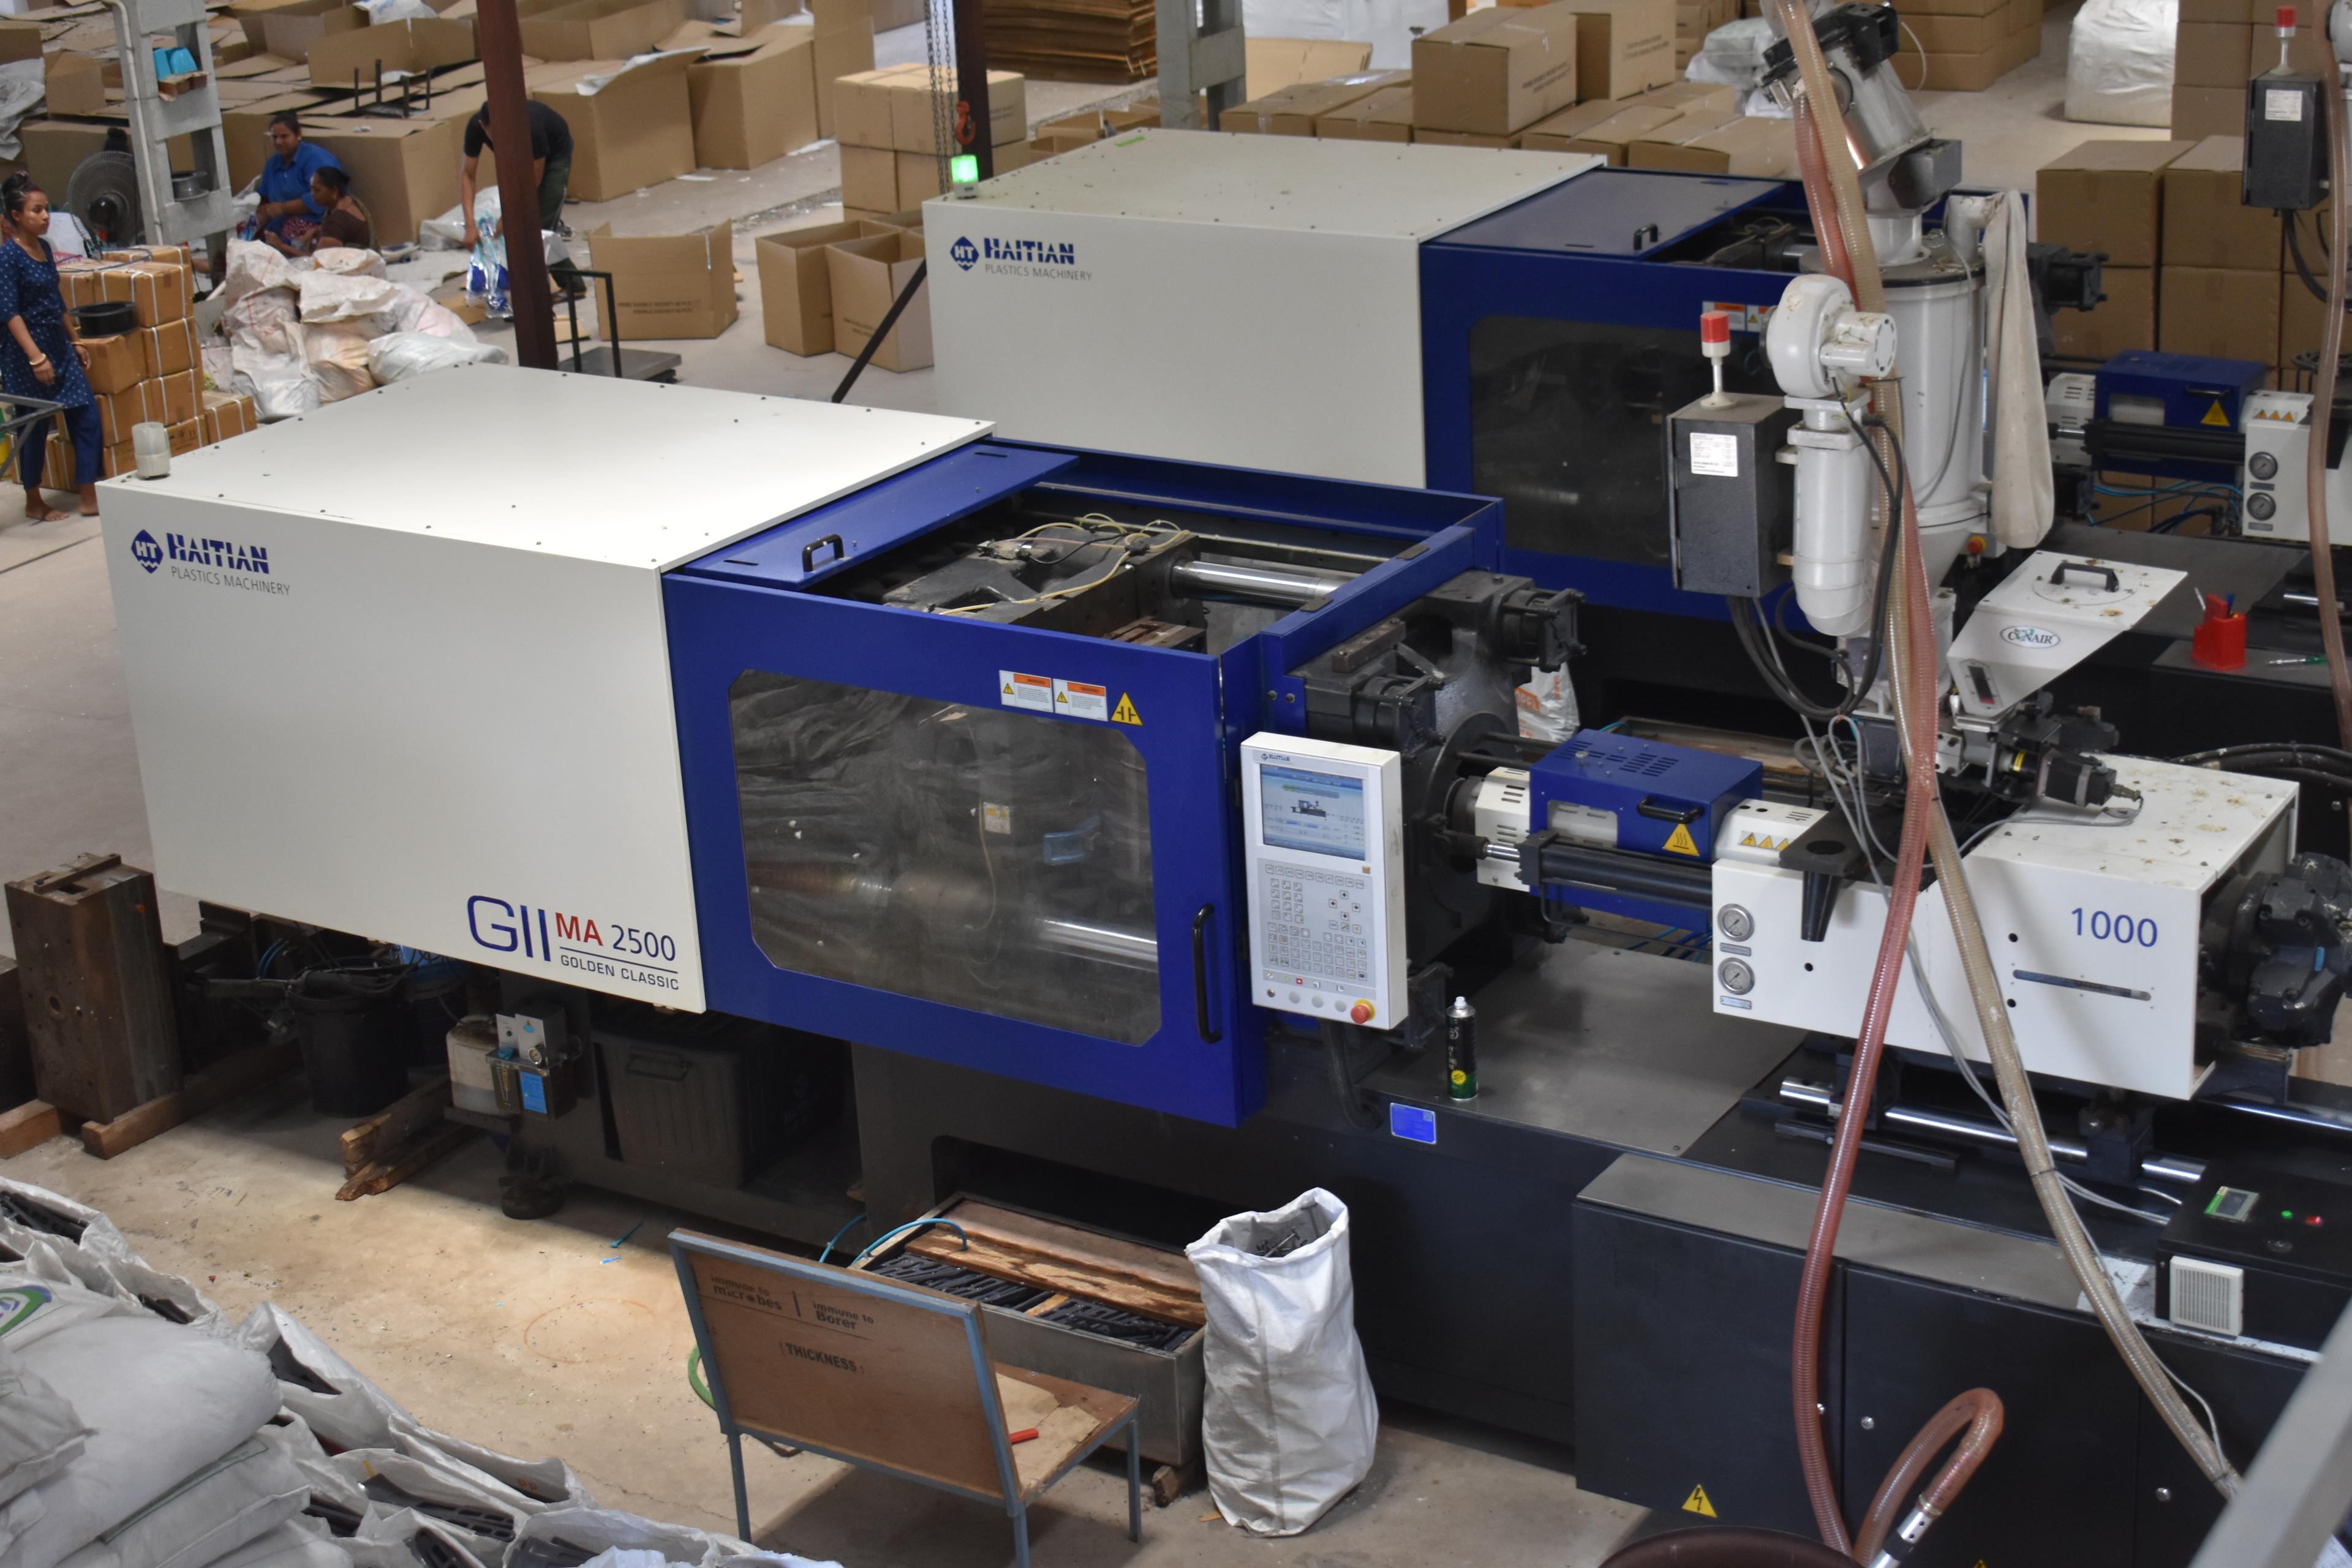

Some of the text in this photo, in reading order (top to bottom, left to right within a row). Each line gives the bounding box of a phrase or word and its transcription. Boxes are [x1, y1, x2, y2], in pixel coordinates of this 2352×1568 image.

[984, 237, 1076, 265] HAITIAN
[985, 263, 1093, 282] PLASTICS MACHINERY
[135, 532, 270, 575] HT HAITIAN
[171, 565, 291, 597] PLASTICS MACHINERY
[555, 911, 604, 947] MA
[611, 924, 676, 962] 2500
[2071, 907, 2158, 948] 1000
[560, 955, 680, 990] GOLDEN CLASSIC
[711, 1274, 770, 1296] immune to
[813, 1302, 874, 1324] immune to
[816, 1310, 857, 1330] Borer
[785, 1343, 858, 1373] THICKNESS
